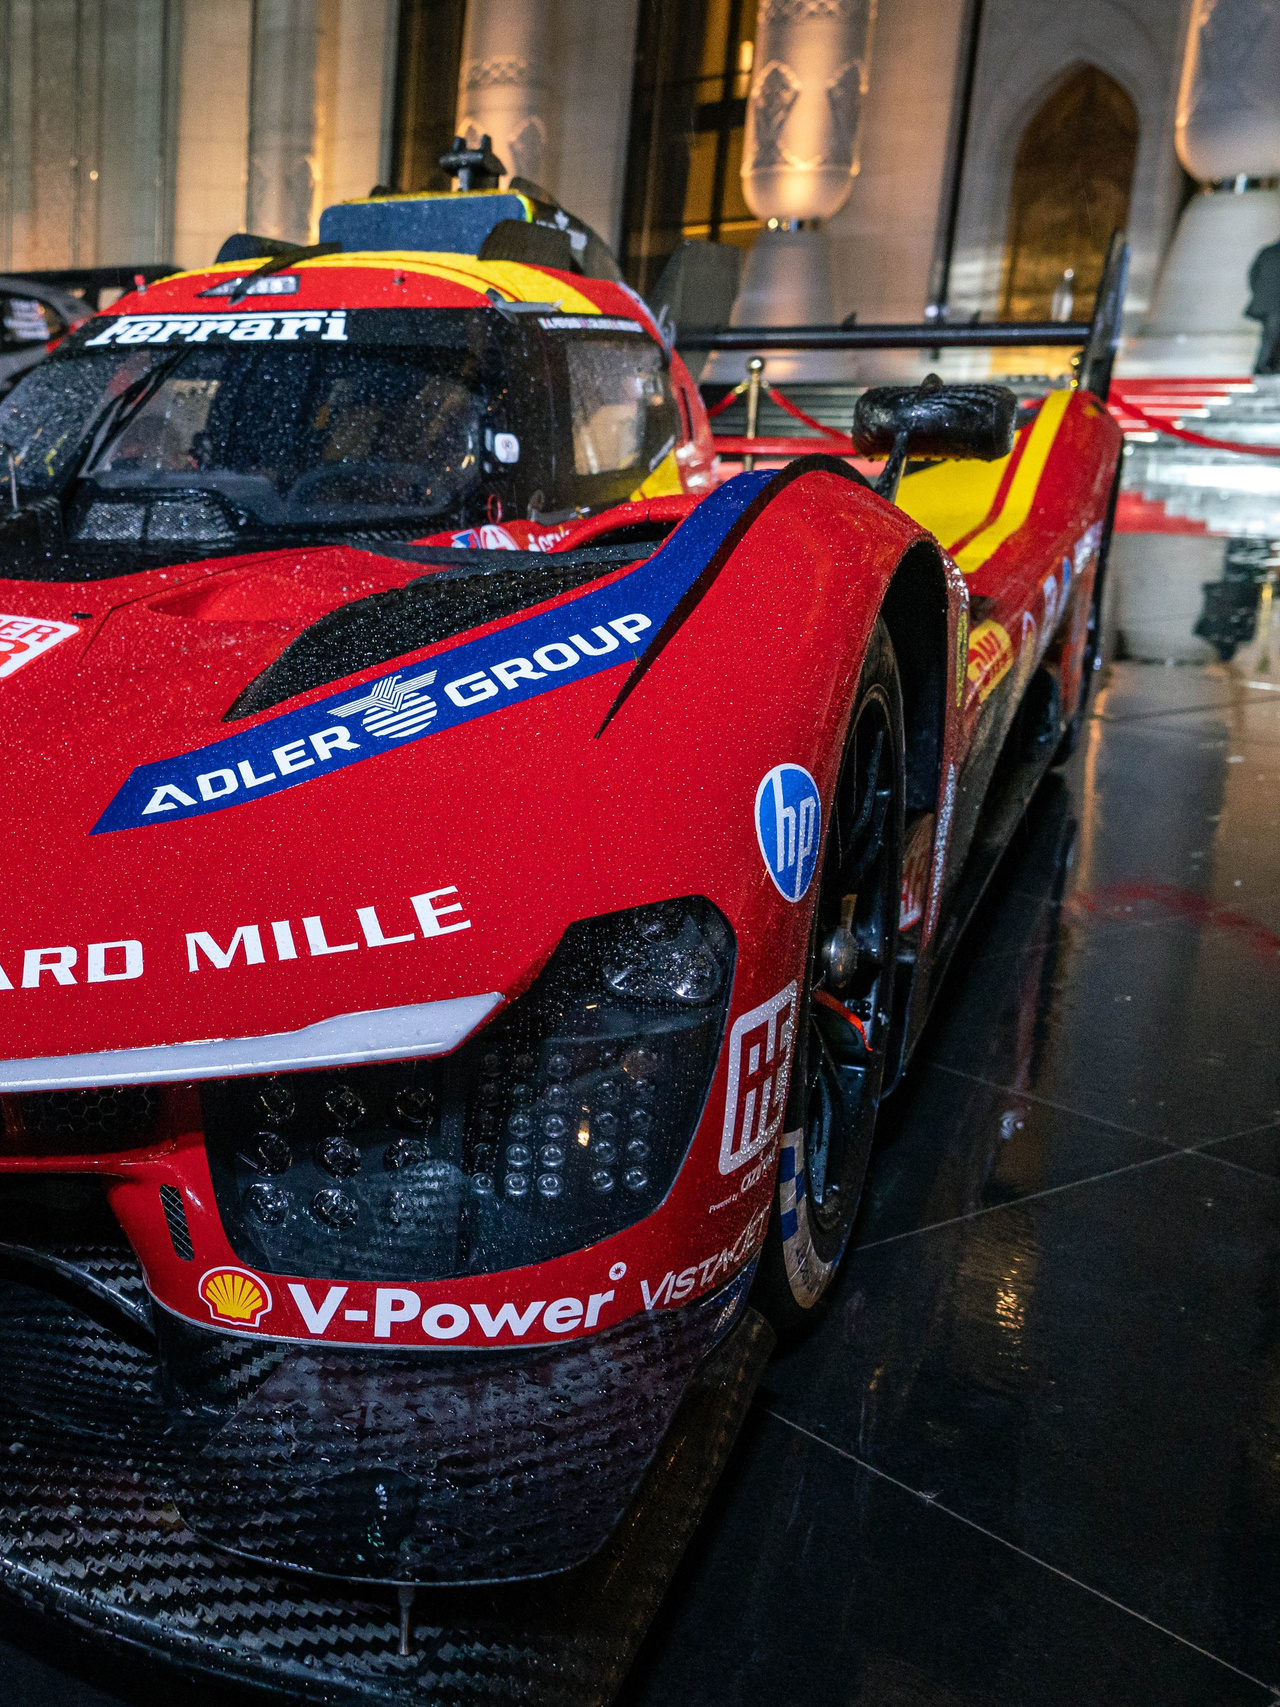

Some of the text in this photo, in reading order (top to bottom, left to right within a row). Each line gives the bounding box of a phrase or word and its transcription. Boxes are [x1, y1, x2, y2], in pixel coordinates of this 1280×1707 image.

[85, 311, 349, 347] Ferrari
[141, 613, 652, 815] ADLER GROUP
[771, 769, 817, 900] hp
[187, 885, 472, 973] MILLE
[286, 1283, 615, 1340] V-Power
